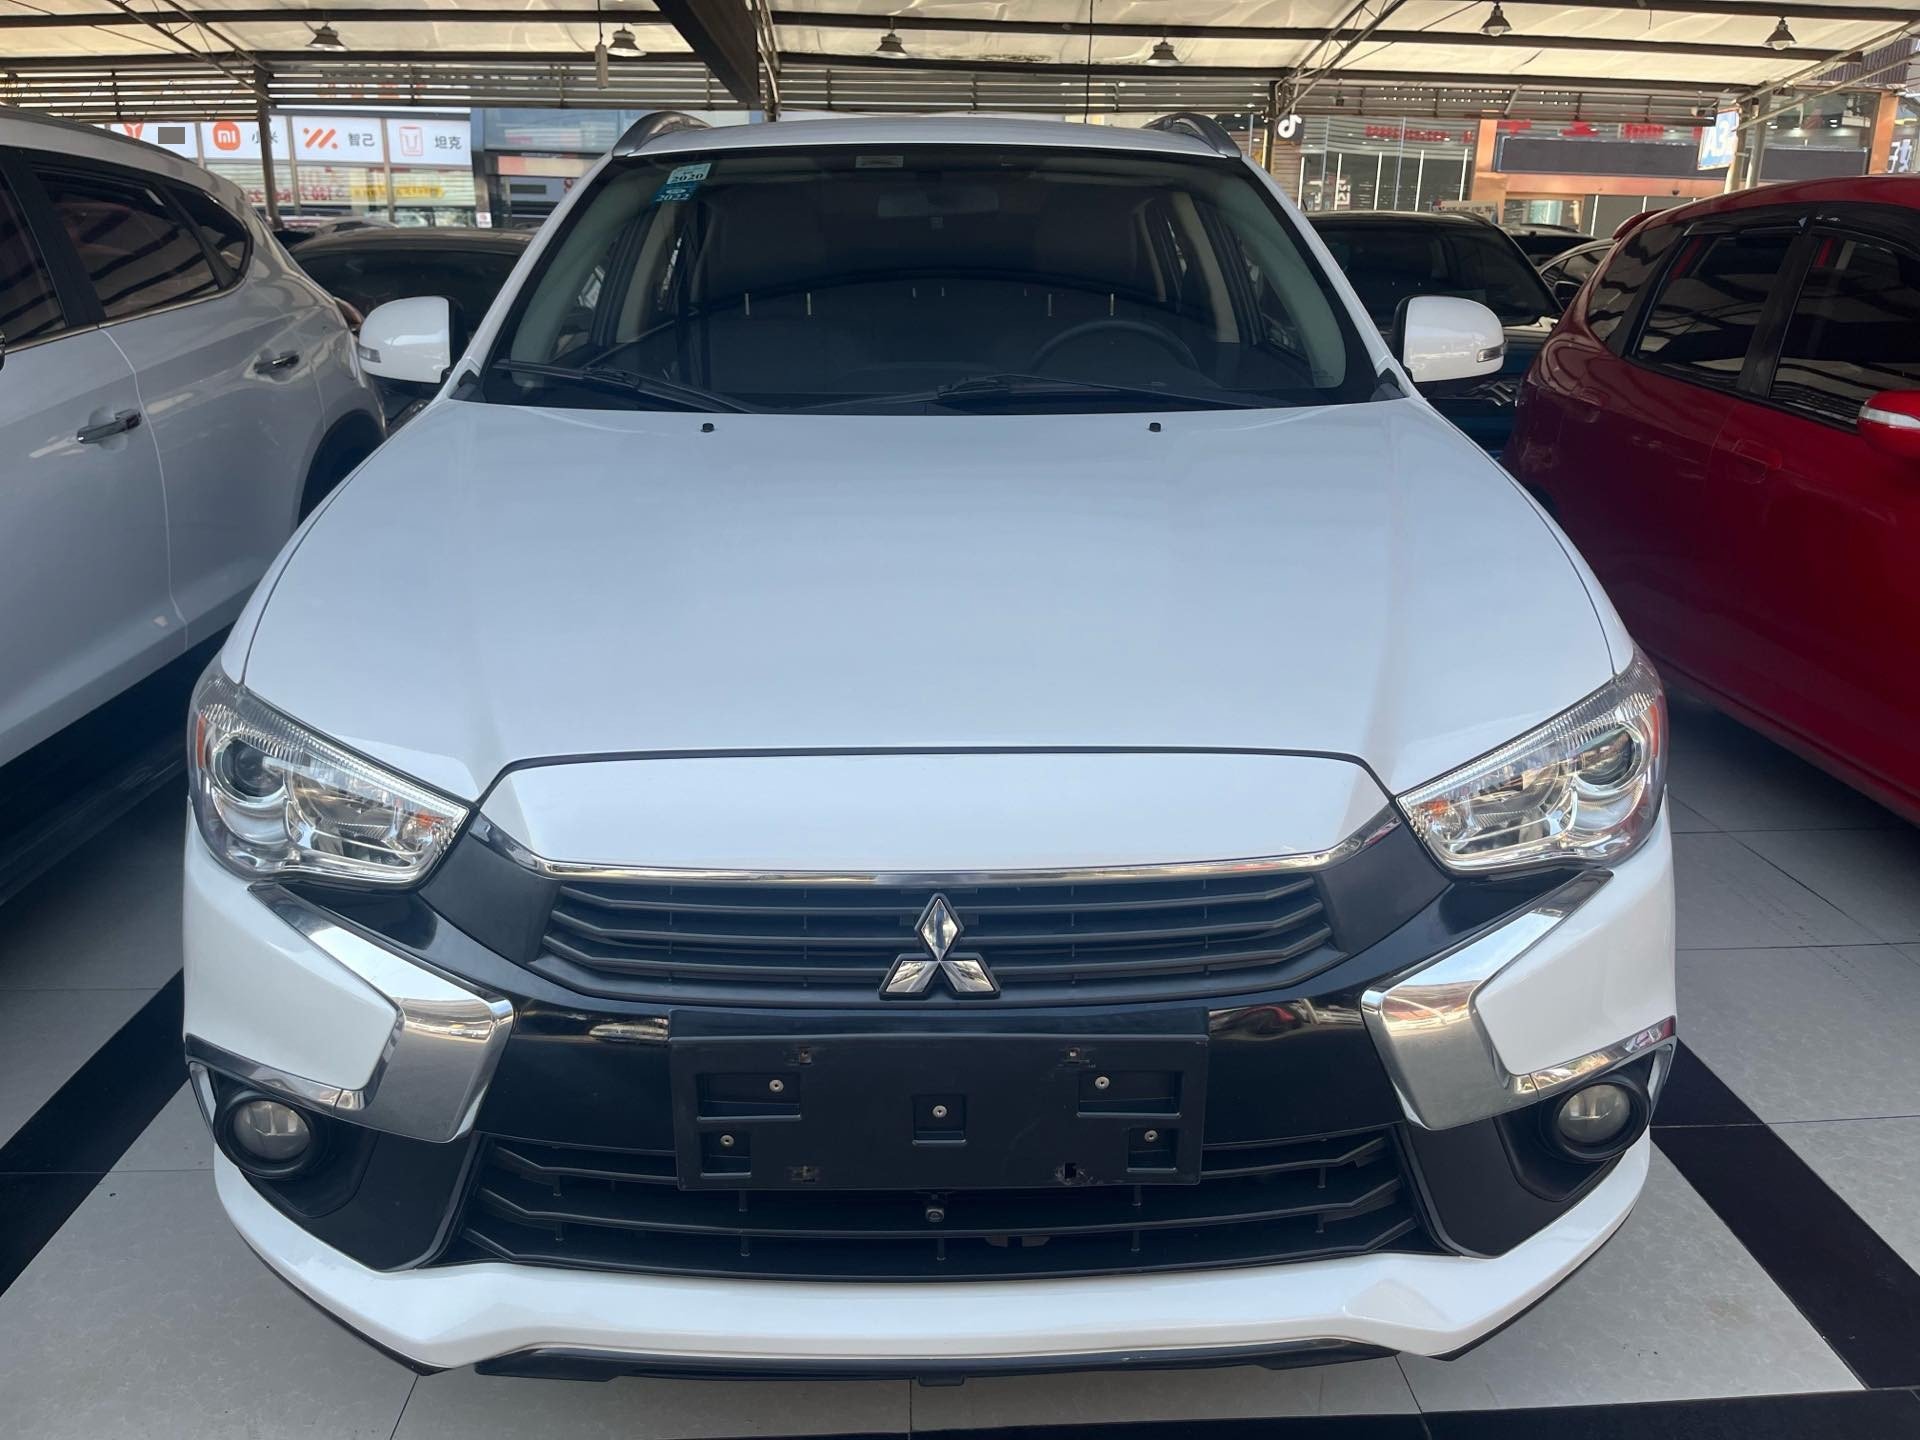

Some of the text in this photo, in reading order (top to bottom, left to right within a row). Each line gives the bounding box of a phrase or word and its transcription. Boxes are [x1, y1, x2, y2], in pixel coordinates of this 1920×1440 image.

[348, 133, 375, 147] 智己
[434, 135, 462, 150] 坦克
[672, 173, 704, 182] 2020
